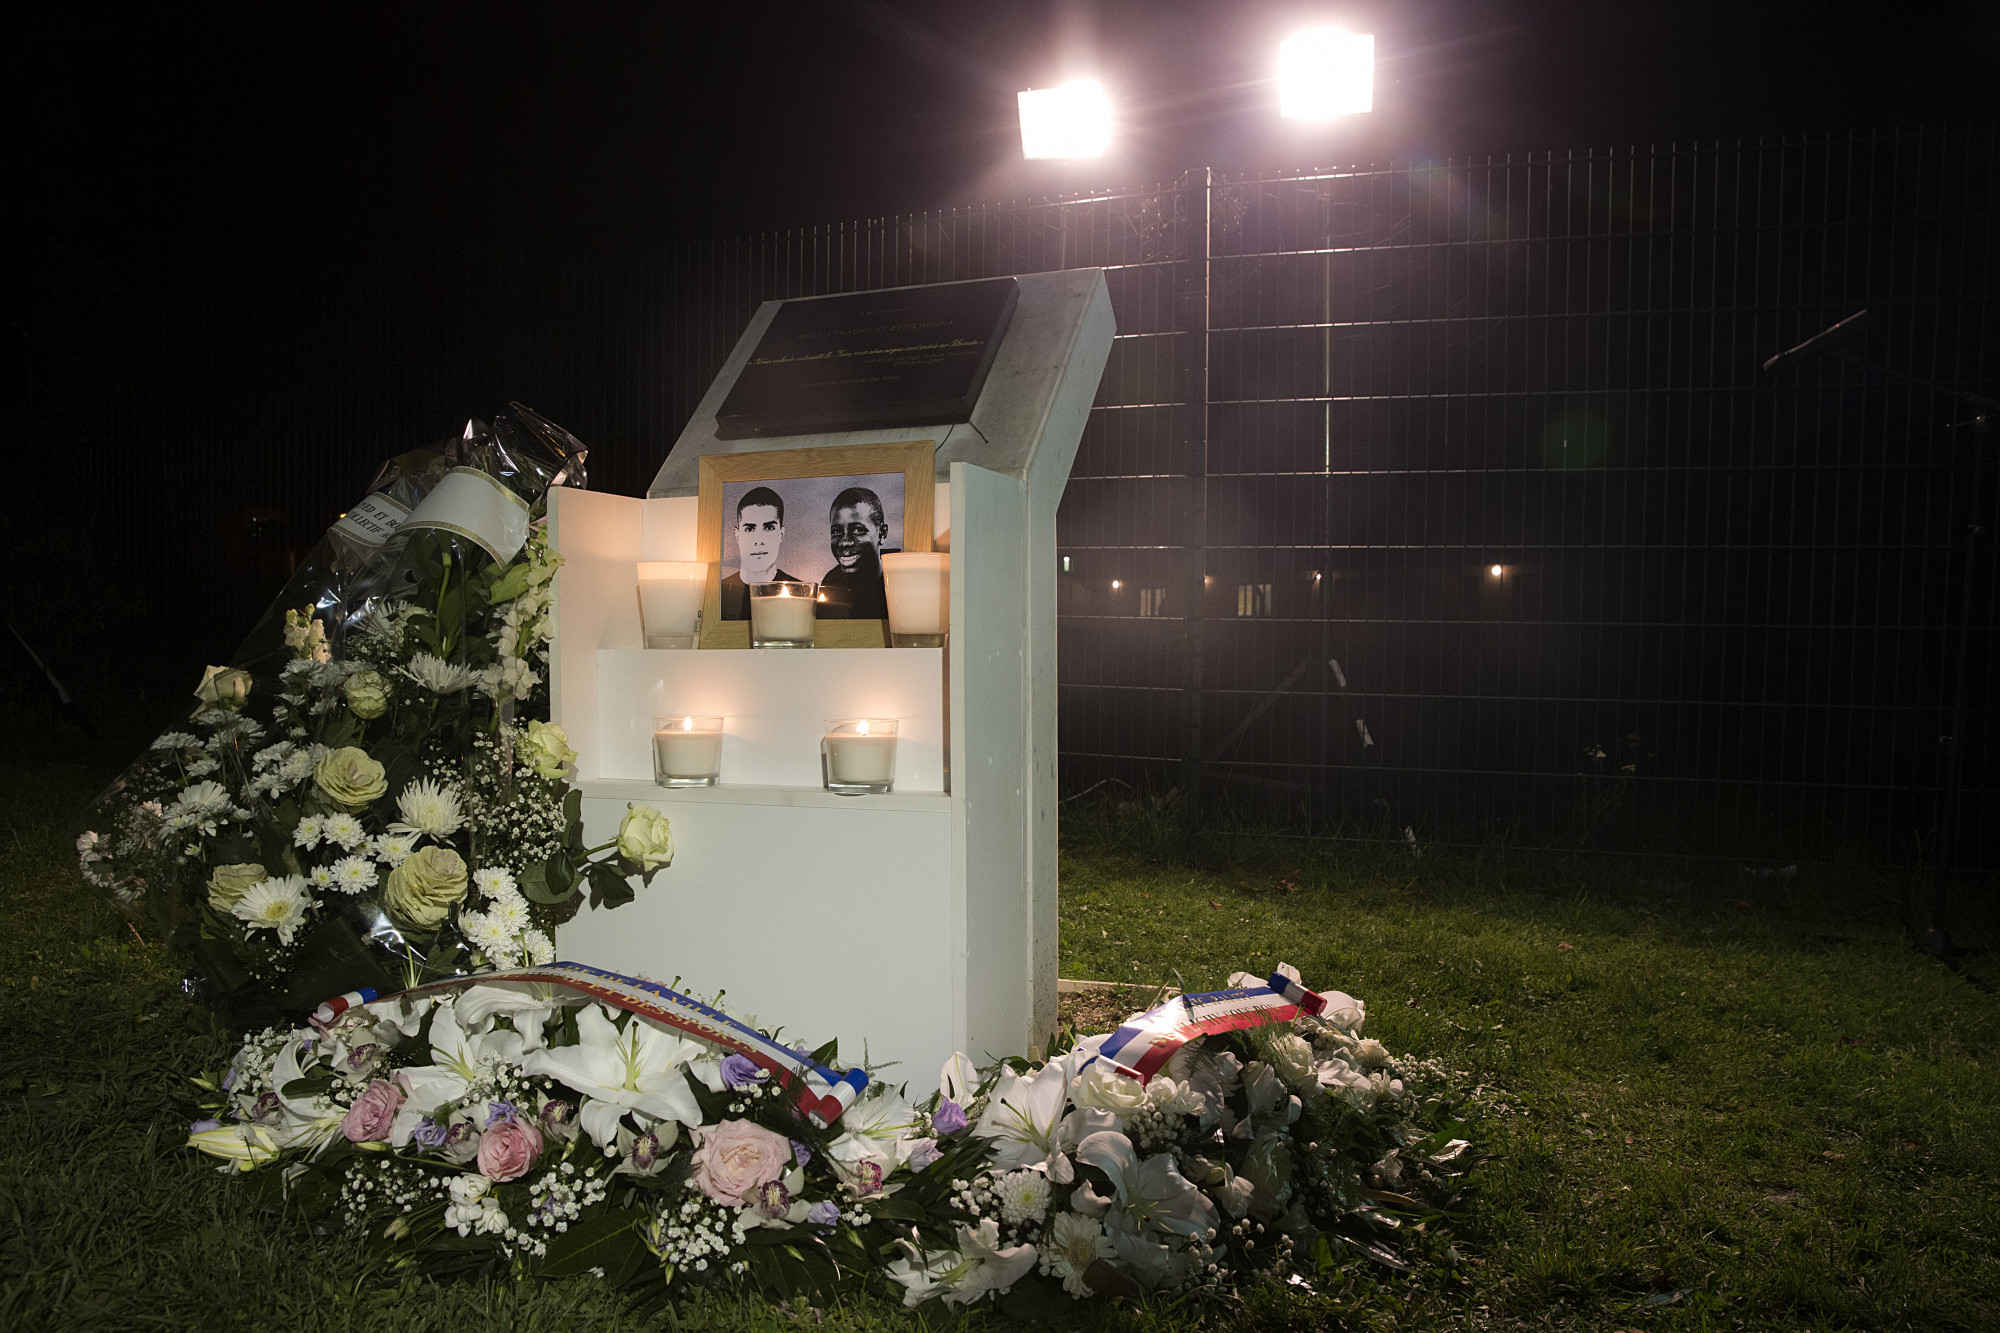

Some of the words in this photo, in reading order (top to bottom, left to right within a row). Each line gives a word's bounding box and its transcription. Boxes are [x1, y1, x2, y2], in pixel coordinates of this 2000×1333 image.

[373, 511, 389, 520] ET
[587, 981, 622, 995] ET
[621, 993, 670, 1015] DES
[668, 1011, 758, 1053] SPORTS
[598, 973, 630, 984] DE
[632, 983, 661, 998] LA
[671, 995, 738, 1033] VILLE
